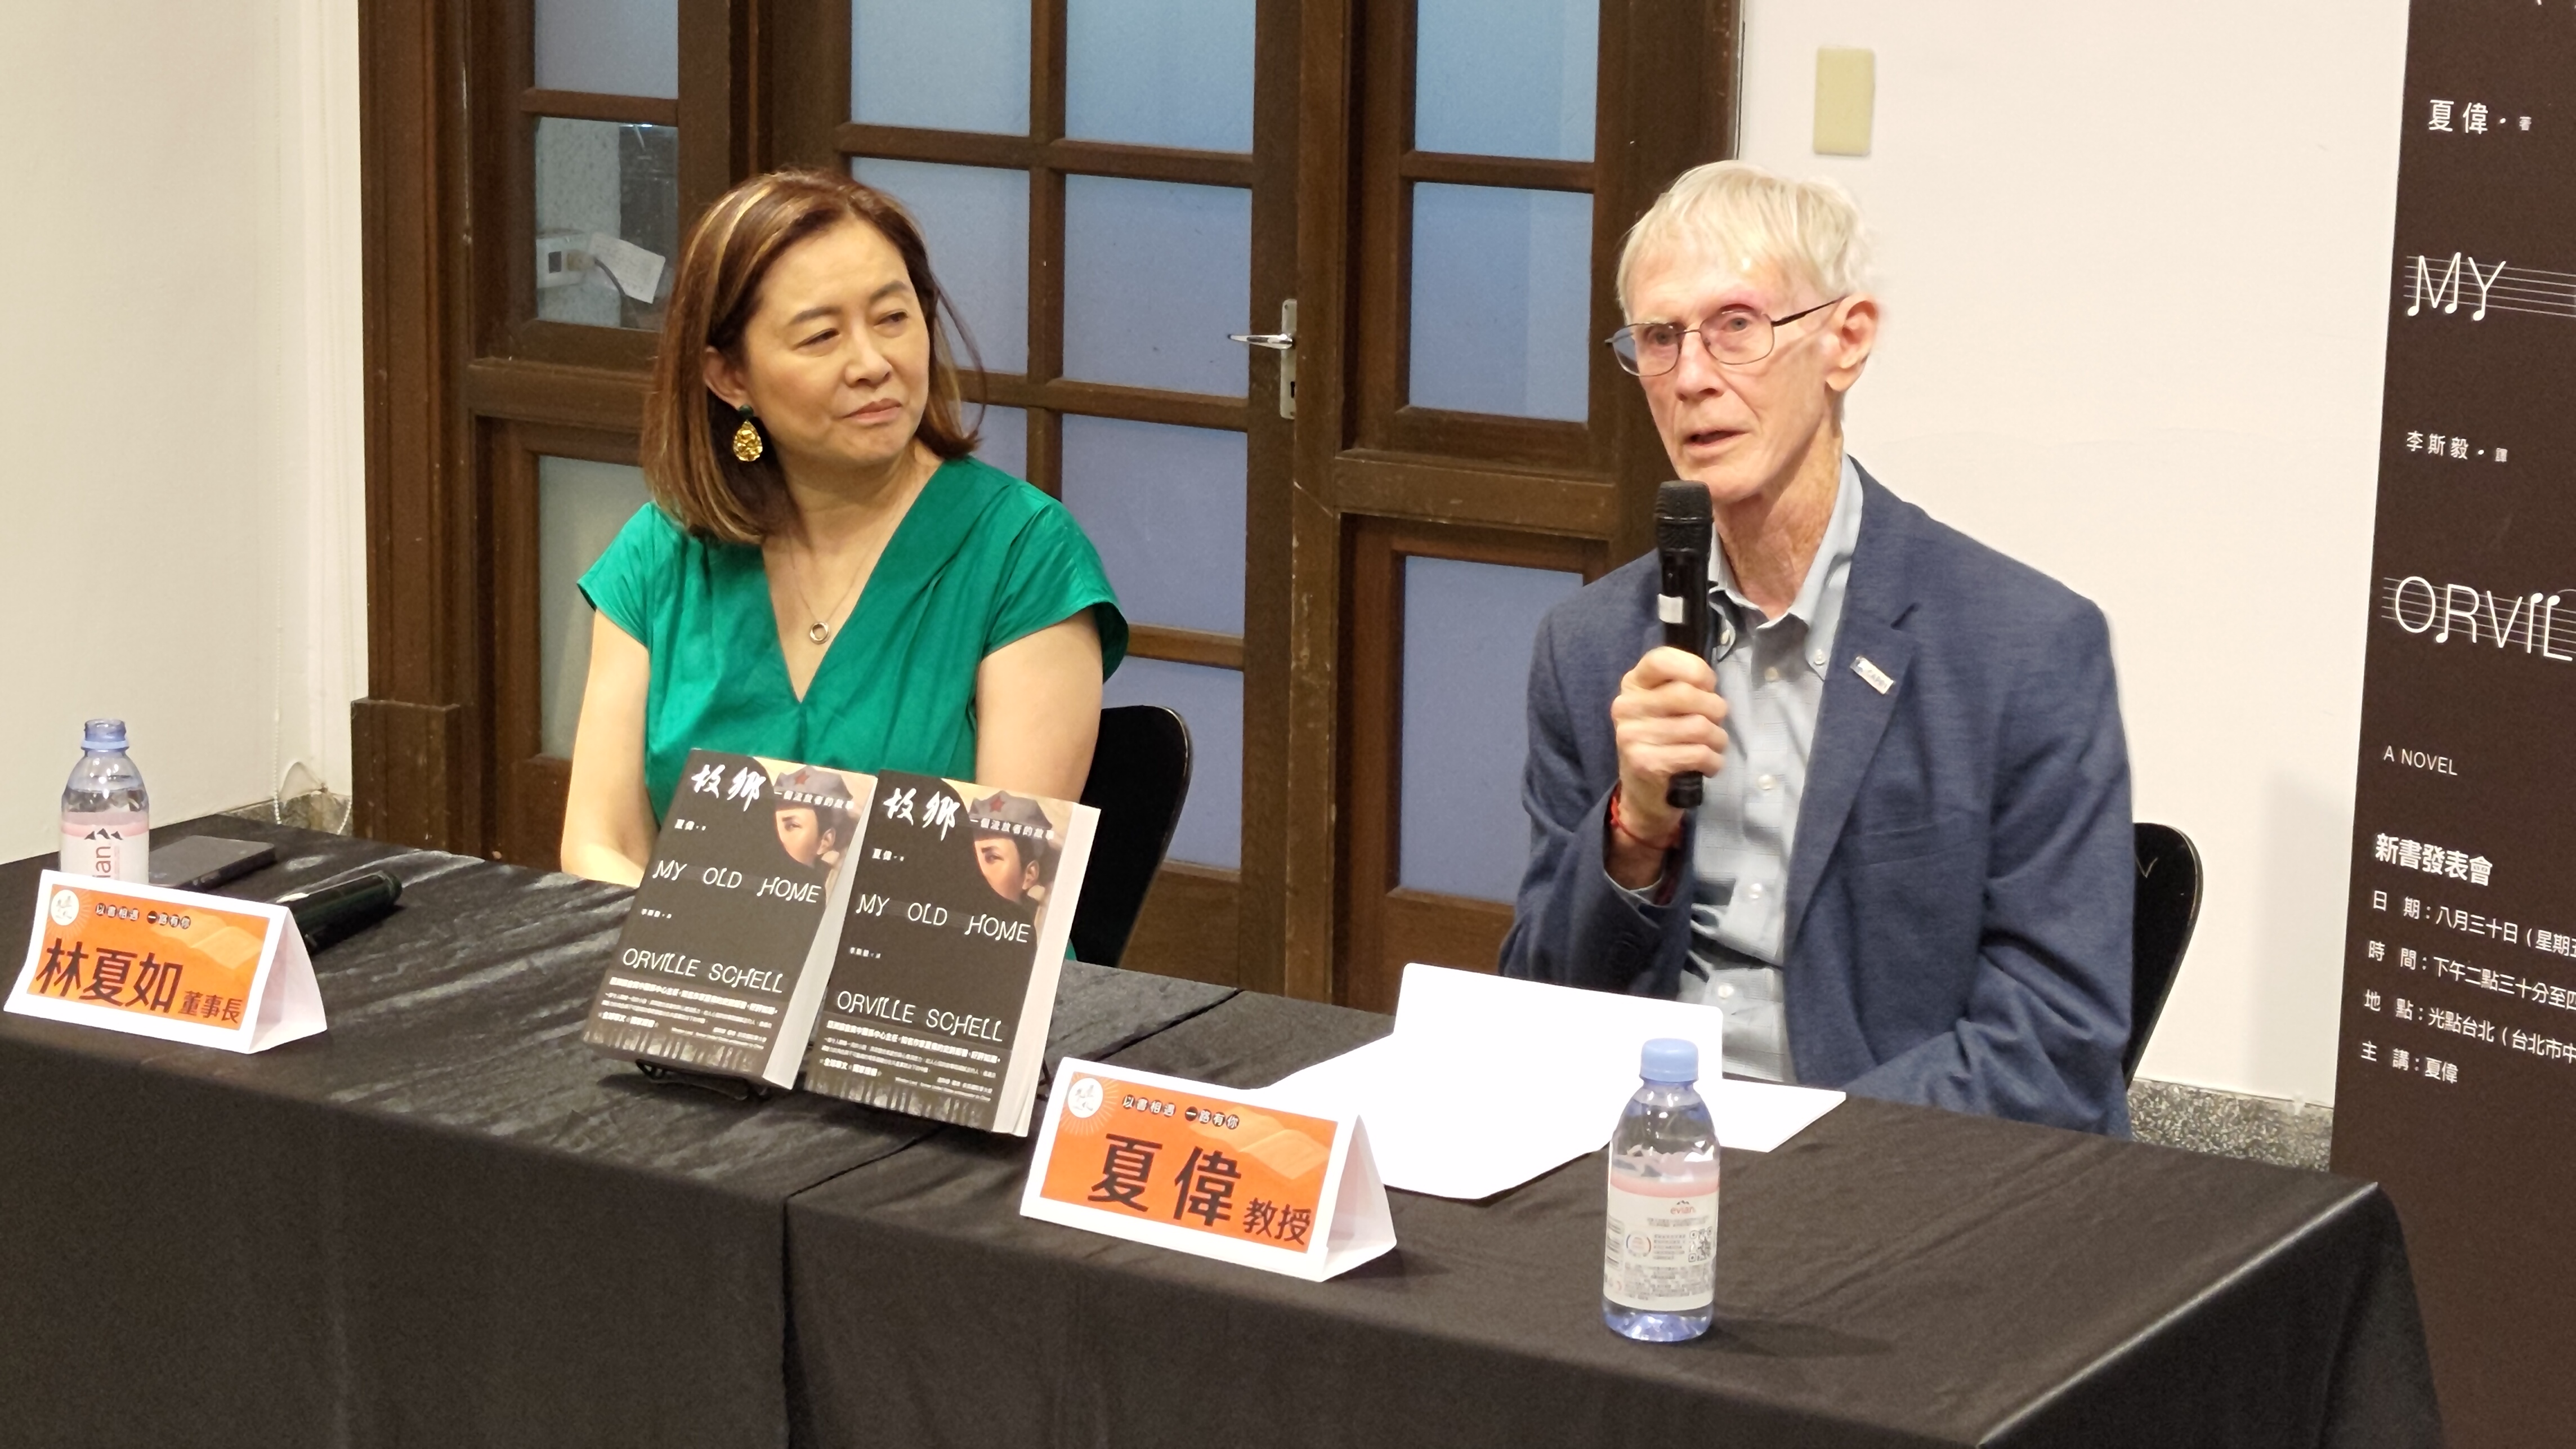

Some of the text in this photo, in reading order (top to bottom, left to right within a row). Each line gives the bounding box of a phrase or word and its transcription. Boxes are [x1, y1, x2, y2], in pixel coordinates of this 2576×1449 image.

[2407, 252, 2506, 321] MY
[2383, 745, 2458, 776] A NOVEL
[92, 846, 111, 878] ian
[652, 860, 822, 904] MY OLD HOME
[2375, 832, 2493, 887] 新書發表會
[856, 894, 1031, 943] MY OLD HOME
[35, 937, 243, 1024] 林夏如 董事長
[623, 948, 783, 994] ORVILLE SCHELL
[837, 991, 916, 1024] ORVILLE
[925, 1009, 1003, 1042] SCHELL
[1088, 1133, 1312, 1246] 夏偉 教授
